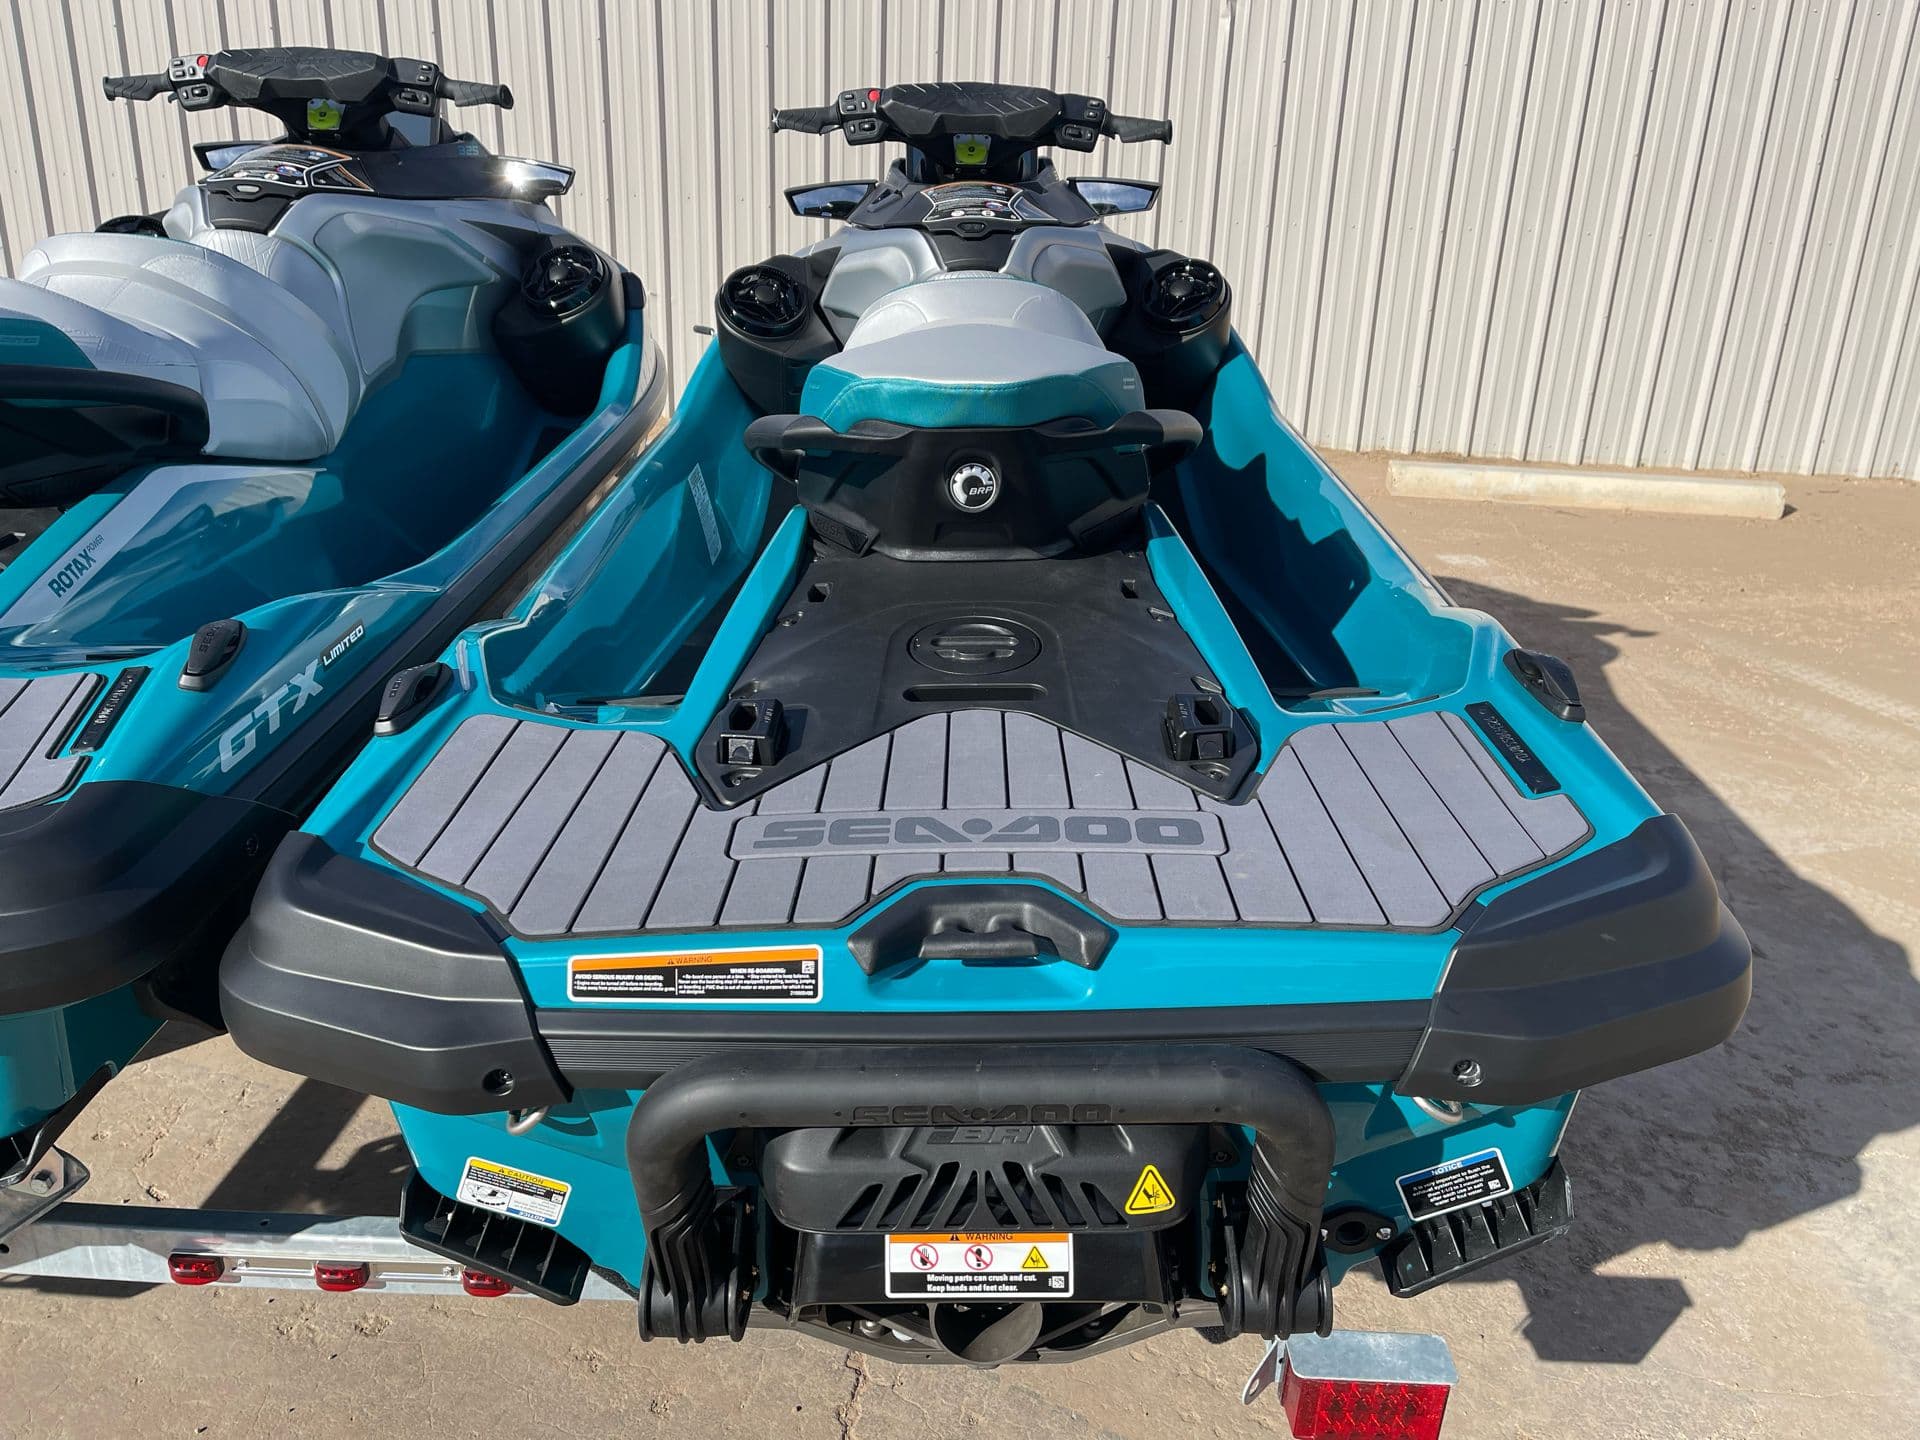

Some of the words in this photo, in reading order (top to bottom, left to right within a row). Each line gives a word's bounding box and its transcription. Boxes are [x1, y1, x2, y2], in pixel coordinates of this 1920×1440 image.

[969, 486, 993, 496] BRP
[48, 549, 96, 597] ROTAX
[219, 659, 324, 773] GTX
[323, 625, 364, 666] LIMITED
[675, 955, 713, 966] WARNING
[1432, 1162, 1463, 1176] NOTICE
[1435, 1173, 1461, 1184] important
[1467, 1166, 1481, 1175] flush
[507, 1170, 545, 1185] CAUTION
[965, 1232, 1014, 1241] WARNING
[927, 1274, 954, 1283] Moving
[955, 1274, 973, 1283] parts
[988, 1274, 1008, 1282] crush
[1009, 1274, 1023, 1282] and
[927, 1284, 946, 1293] Keep
[946, 1284, 968, 1292] hands
[969, 1284, 982, 1292] and
[983, 1284, 997, 1292] feet
[998, 1284, 1019, 1292] clear.
